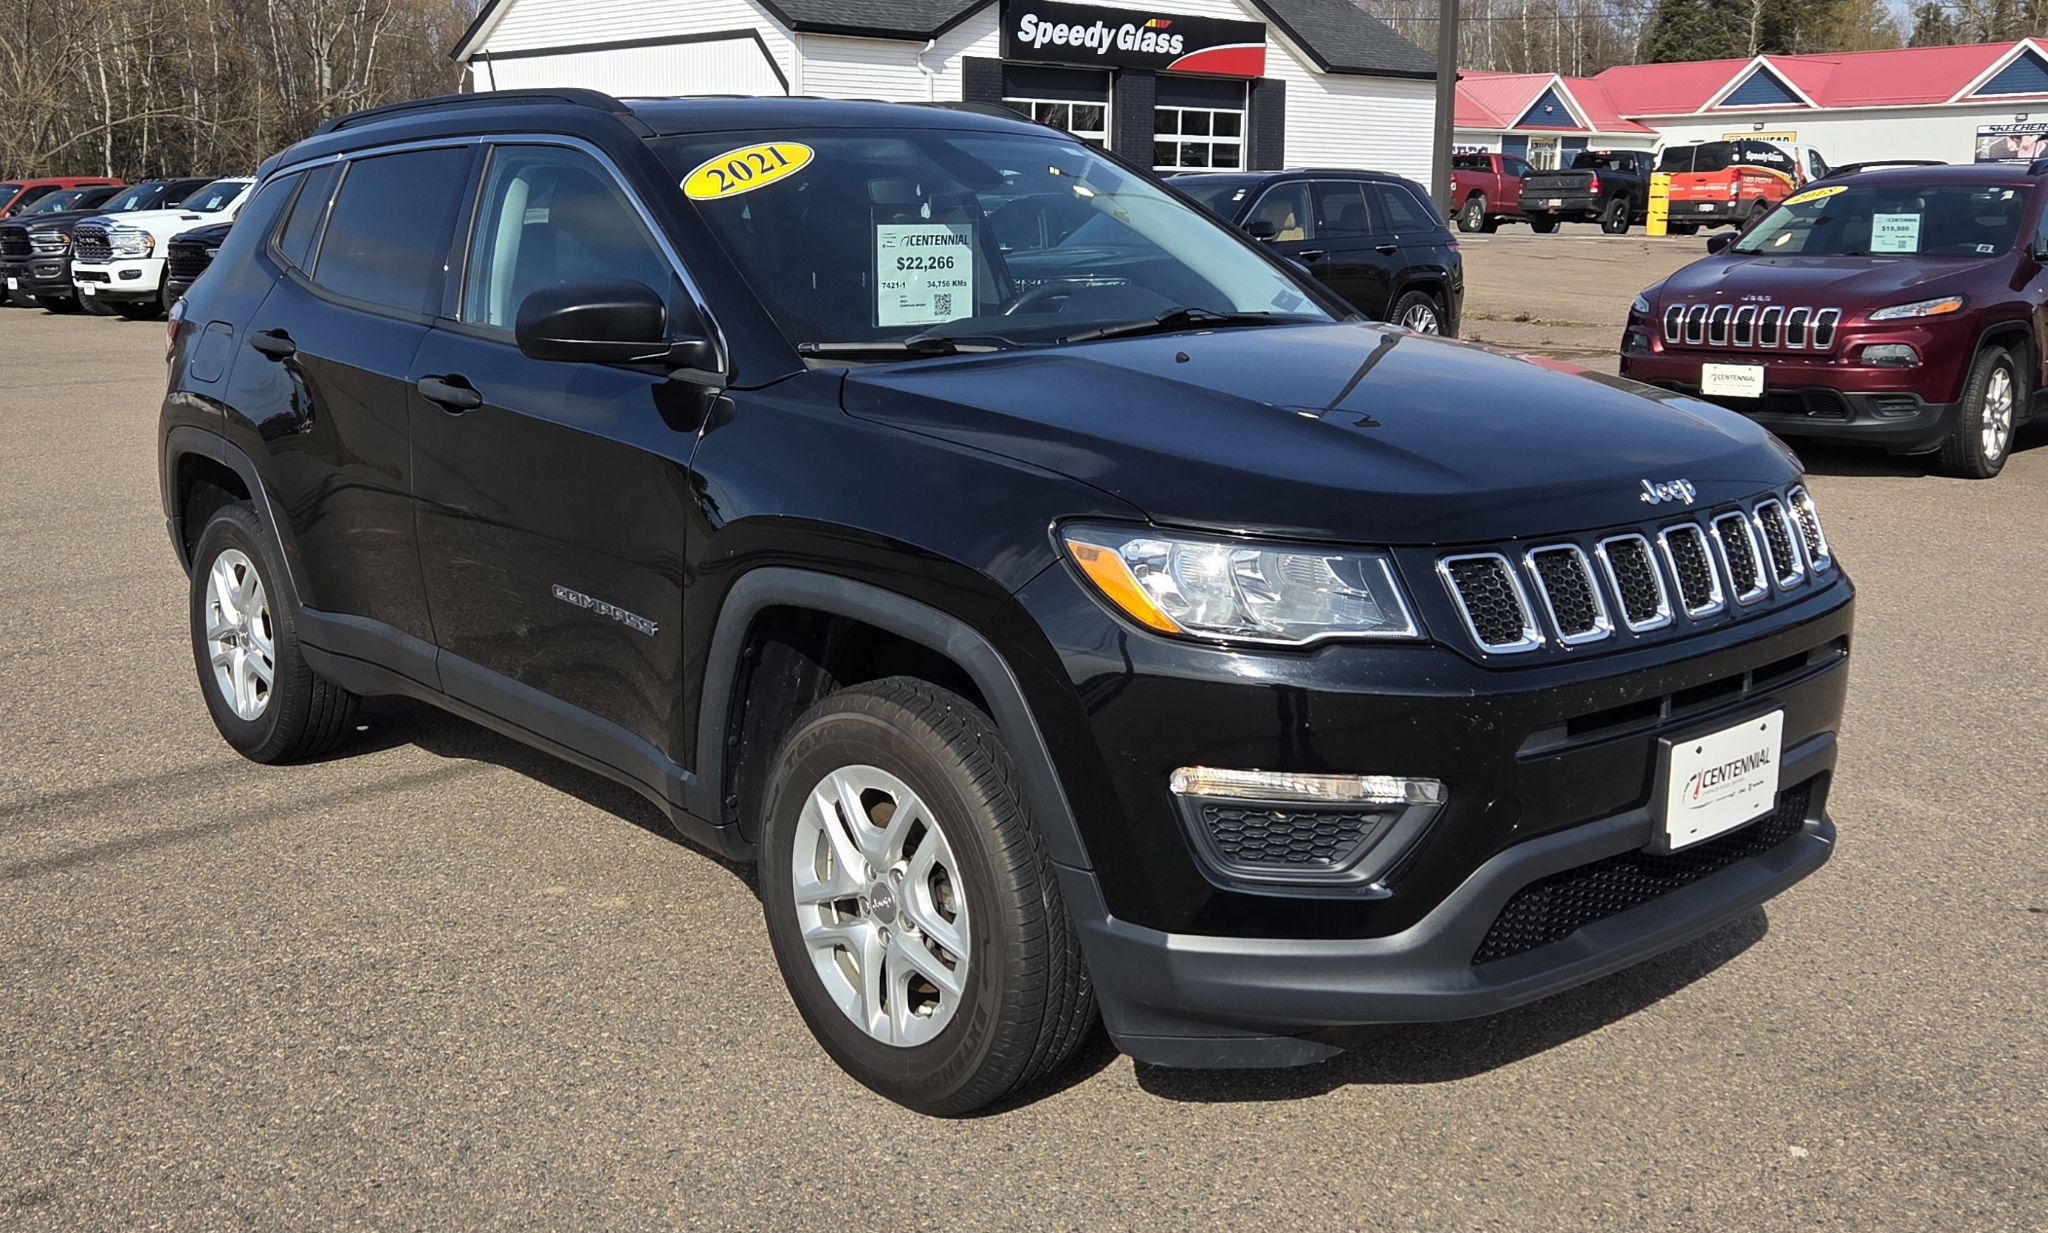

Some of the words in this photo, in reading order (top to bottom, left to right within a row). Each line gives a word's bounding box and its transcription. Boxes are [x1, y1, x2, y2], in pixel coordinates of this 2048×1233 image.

[1017, 13, 1117, 55] Speedy
[1117, 23, 1184, 55] Glass
[1989, 123, 2048, 132] SKECHER
[706, 146, 792, 193] 2021
[909, 234, 970, 246] CENTENNIAL
[896, 256, 955, 272] $22,266
[926, 280, 950, 289] 34,756
[1640, 478, 1697, 506] Jeep
[551, 583, 659, 637] COMPASS
[1702, 746, 1771, 789] CENTENNIAL
